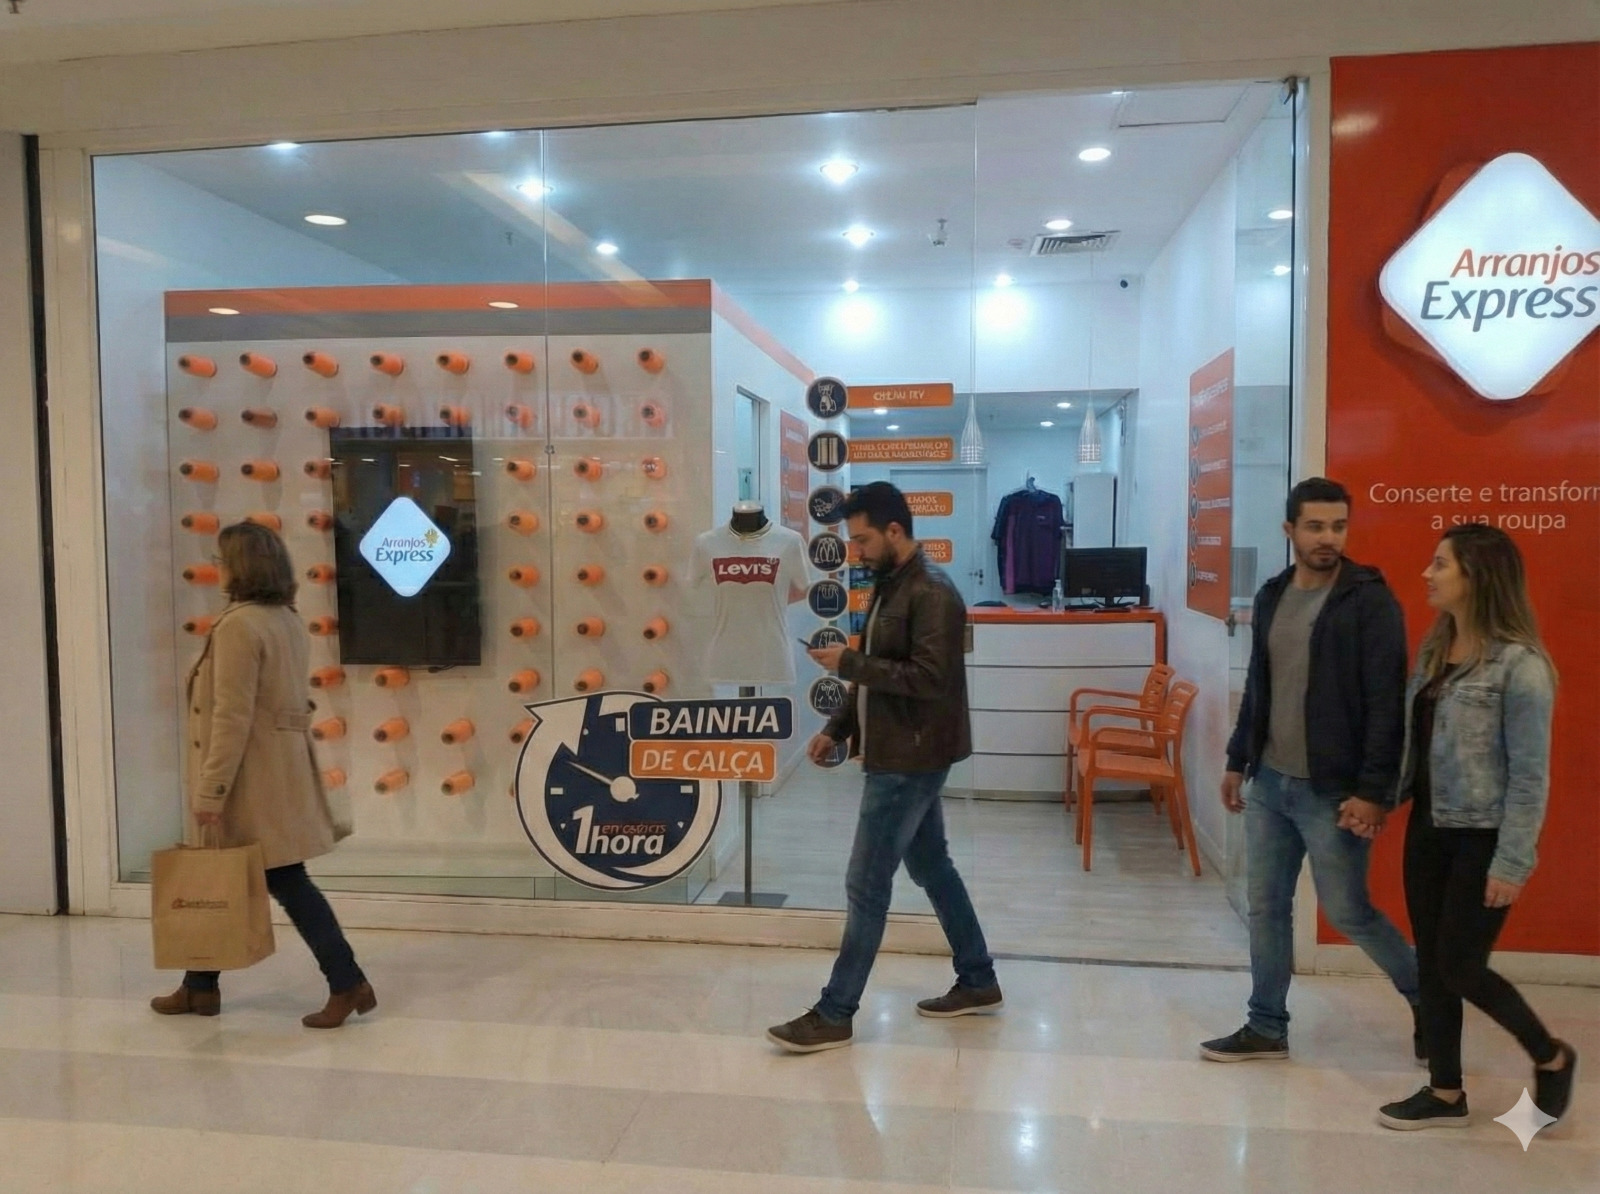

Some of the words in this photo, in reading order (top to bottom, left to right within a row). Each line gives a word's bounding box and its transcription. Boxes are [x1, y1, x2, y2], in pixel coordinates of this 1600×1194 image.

[1450, 245, 1600, 284] Arranjos
[1420, 280, 1598, 332] Express
[1369, 483, 1472, 503] Conserte
[1479, 487, 1493, 502] e
[1431, 514, 1444, 530] a
[1497, 514, 1566, 535] roupa
[375, 547, 435, 566] Express
[381, 537, 426, 551] Arranjos
[650, 705, 779, 735] BAINHA
[641, 749, 677, 772] DE
[682, 750, 764, 778] CALÇA
